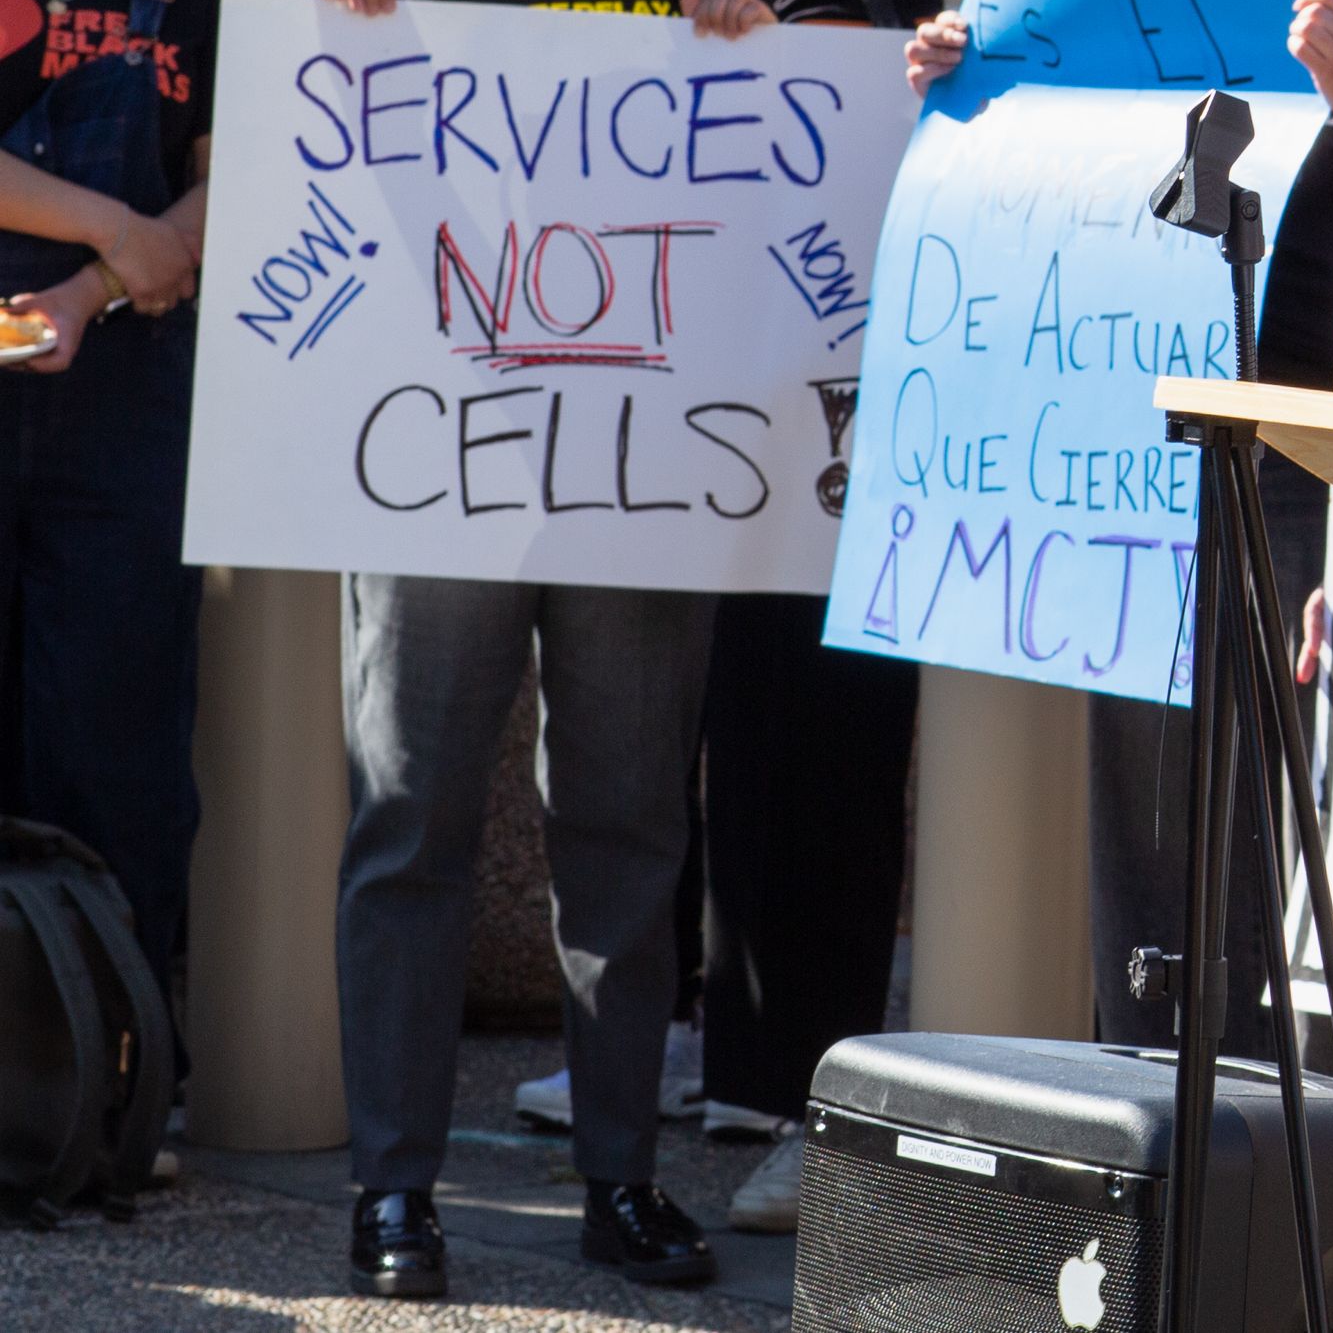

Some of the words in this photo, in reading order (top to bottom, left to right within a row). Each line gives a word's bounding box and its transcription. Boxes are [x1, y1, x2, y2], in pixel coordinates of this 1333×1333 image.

[49, 9, 129, 34] FRE
[294, 53, 842, 187] SERVICES
[236, 181, 379, 345] NOW!
[436, 220, 727, 356] NOT
[786, 221, 871, 350] NOW!
[1030, 400, 1199, 520] CIERRE
[902, 1141, 929, 1154] DIGNITY
[929, 1148, 944, 1161] AND
[945, 1150, 973, 1164] POWER
[973, 1157, 993, 1169] NOW
